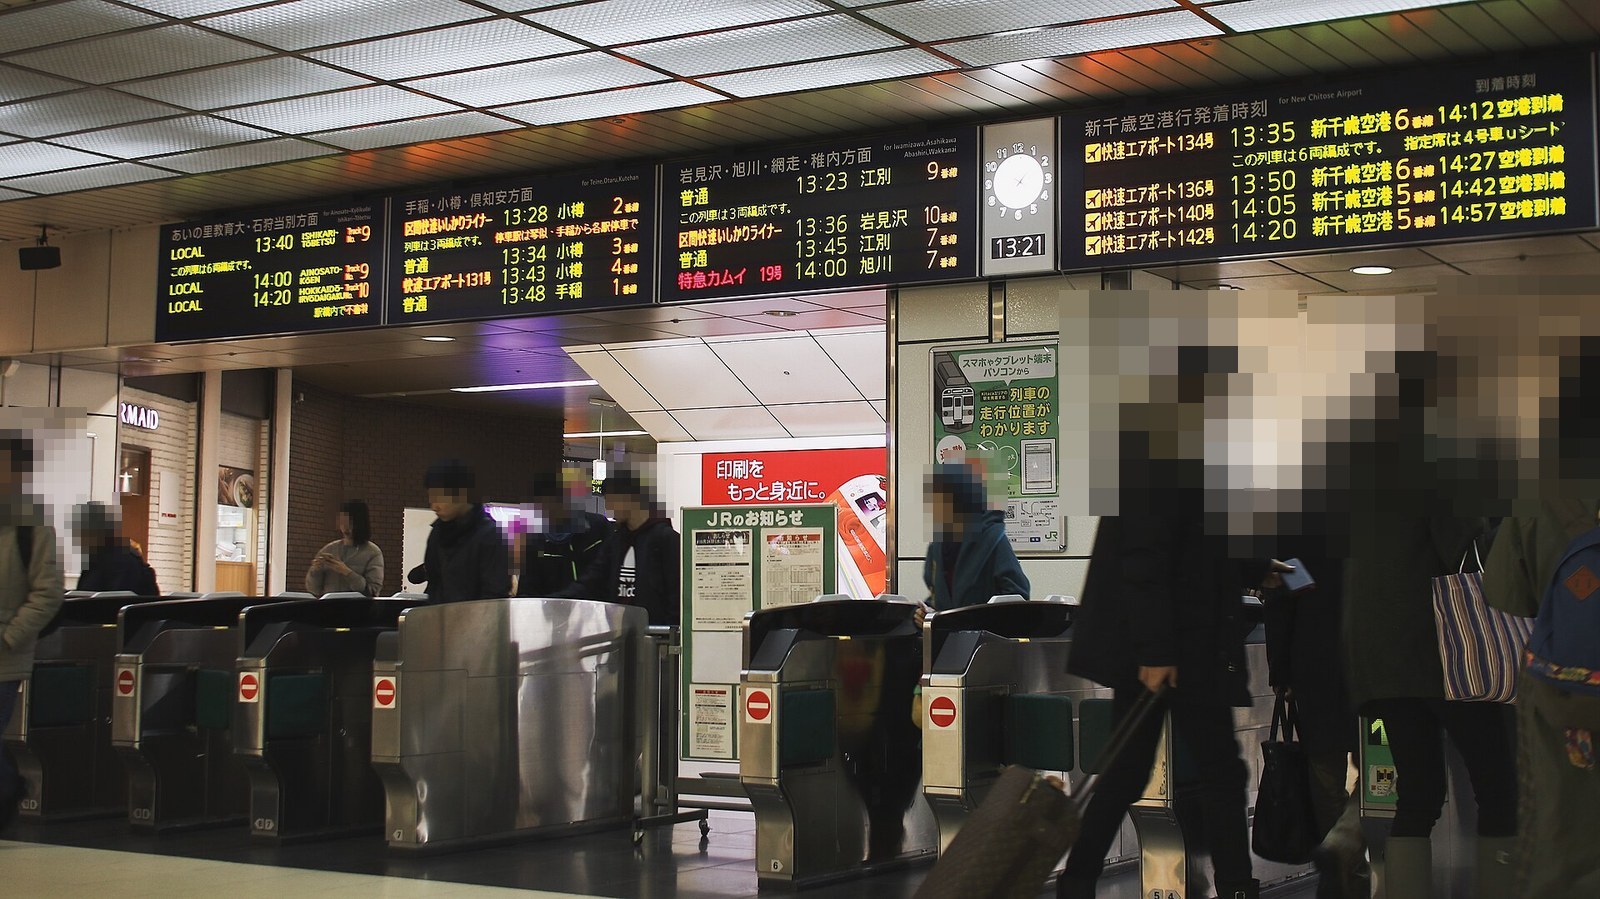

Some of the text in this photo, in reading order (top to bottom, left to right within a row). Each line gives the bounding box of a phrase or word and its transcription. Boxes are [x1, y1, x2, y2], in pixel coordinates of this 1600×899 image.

[1476, 73, 1536, 94] 到着時刻
[1291, 95, 1306, 103] New
[1308, 92, 1335, 100] Chitose
[1337, 88, 1362, 99] Airport
[1085, 100, 1268, 137] 新千歳空港行発着時刻
[1102, 132, 1214, 162] 快速エアポート134号
[1231, 121, 1296, 147] 13:35
[1440, 102, 1496, 123] 14:12
[997, 148, 1007, 159] 11
[1012, 142, 1024, 153] 12
[1031, 146, 1036, 155] 1
[680, 147, 872, 184] 岩見沢・旭川・網走・稚内方面
[986, 162, 998, 172] 10
[1041, 156, 1049, 166] 2
[680, 188, 709, 207] 普通
[796, 172, 847, 194] 13:23
[860, 168, 891, 187] 江別
[985, 179, 992, 190] 9
[1045, 173, 1052, 183] 3
[1102, 180, 1214, 208] 快速エアポート136号
[1231, 170, 1296, 195] 13:50
[1440, 151, 1496, 174] 14:27
[406, 187, 533, 215] 手稲・小樽・倶知安方面
[988, 196, 996, 206] 8
[1041, 190, 1048, 201] 4
[1102, 204, 1214, 231] 快速エアポート140号
[1231, 194, 1296, 219] 14:05
[1440, 177, 1496, 199] 14:42
[504, 206, 548, 226] 13:28
[558, 202, 584, 220] 小樽
[1000, 207, 1007, 217] 7
[1014, 210, 1022, 220] 6
[1030, 204, 1038, 215] 5
[172, 212, 318, 241] あいの里教育大・石狩当別方面
[362, 226, 370, 241] 9
[679, 224, 782, 248] 区間快速いしかりライナー
[796, 214, 847, 236] 13:36
[860, 209, 908, 230] 岩見沢
[1102, 228, 1214, 254] 快速エアポート142号
[1231, 218, 1296, 243] 14:20
[1440, 202, 1496, 225] 14:57
[171, 235, 293, 260] LOCAL 13:40
[679, 249, 708, 269] 普通
[796, 237, 847, 258] 13:45
[860, 233, 890, 252] 江別
[996, 236, 1042, 258] 13:21
[404, 257, 429, 274] 普通
[502, 245, 546, 265] 13:34
[556, 242, 583, 260] 小樽
[796, 258, 847, 280] 14:00
[860, 255, 892, 274] 旭川
[360, 263, 369, 279] 9
[402, 271, 491, 293] 快速エアポート131号
[502, 265, 546, 284] 13:43
[556, 262, 583, 279] 小樽
[170, 271, 292, 296] LOCAL 14:00
[358, 282, 368, 297] 10
[168, 290, 291, 314] LOCAL 14:20
[402, 296, 427, 313] 普通
[501, 285, 545, 304] 13:48
[555, 282, 583, 300] 手稲
[963, 354, 1051, 367] スマホやタブレット端末
[984, 368, 1029, 377] パソコンから
[1010, 387, 1049, 401] 列車の
[980, 403, 1050, 420] 走行位置が
[980, 421, 1050, 436] わかります
[716, 460, 764, 480] 印刷を
[728, 481, 826, 502] もっと身近に。
[707, 510, 804, 528] JRのお知らせ
